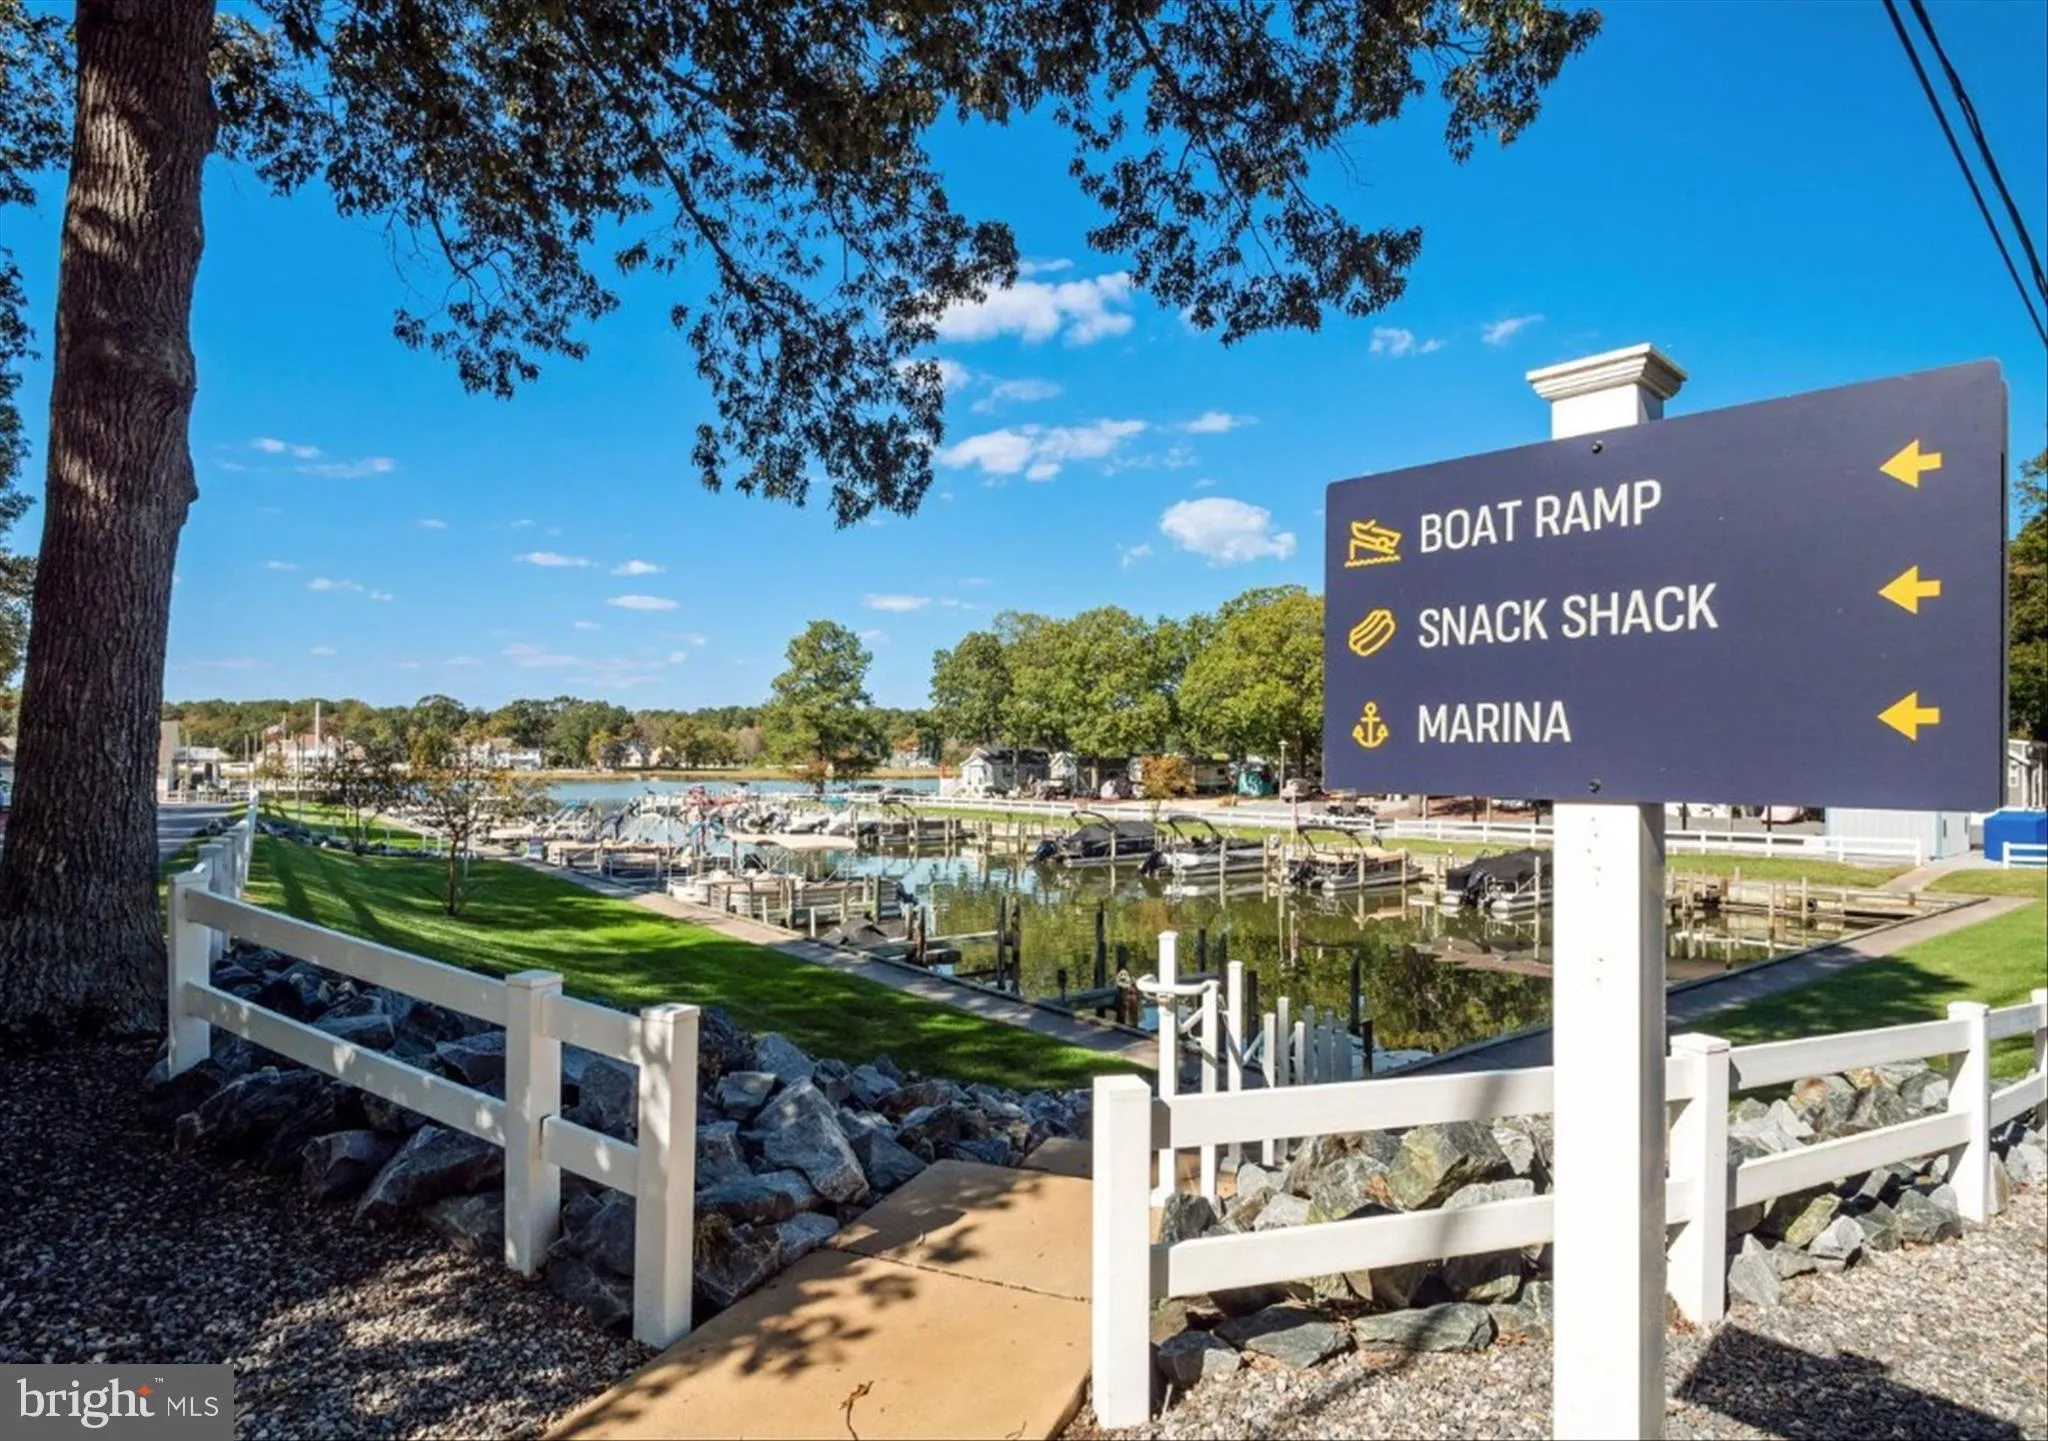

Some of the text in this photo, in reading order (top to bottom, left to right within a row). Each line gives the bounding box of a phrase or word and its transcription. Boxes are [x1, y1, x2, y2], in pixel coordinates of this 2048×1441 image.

[1419, 478, 1663, 555] BOAT RAMP
[1417, 581, 1720, 650] SNACK SHACK
[1417, 699, 1573, 745] MARINA
